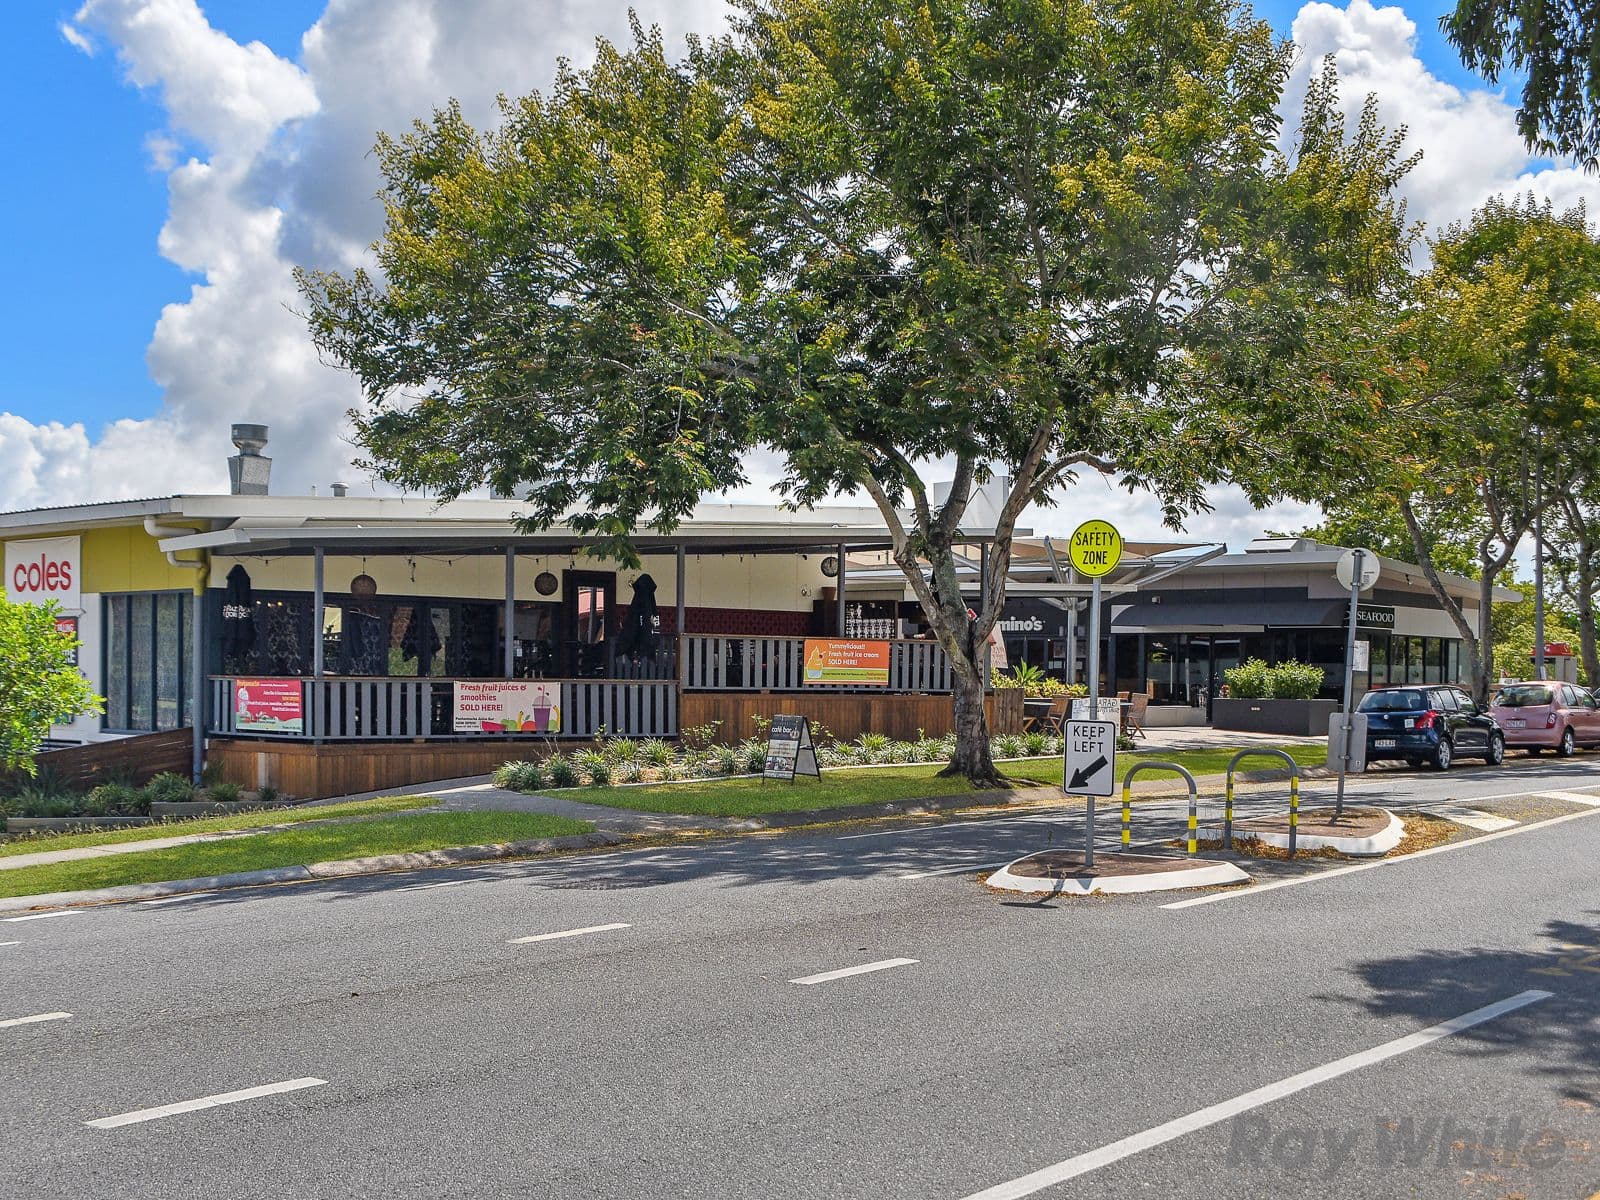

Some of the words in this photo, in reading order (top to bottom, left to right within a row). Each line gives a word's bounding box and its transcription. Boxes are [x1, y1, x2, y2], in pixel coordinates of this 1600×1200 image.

[1075, 531, 1115, 546] SAFETY
[1082, 550, 1108, 565] ZONE
[13, 552, 72, 592] coles
[996, 615, 1044, 631] mino's
[1356, 611, 1394, 622] SEAFOOD
[460, 683, 480, 691] Fresh
[481, 683, 497, 692] fruit
[497, 684, 519, 692] juices
[1073, 725, 1106, 738] KEEP
[1074, 741, 1104, 753] LEFT
